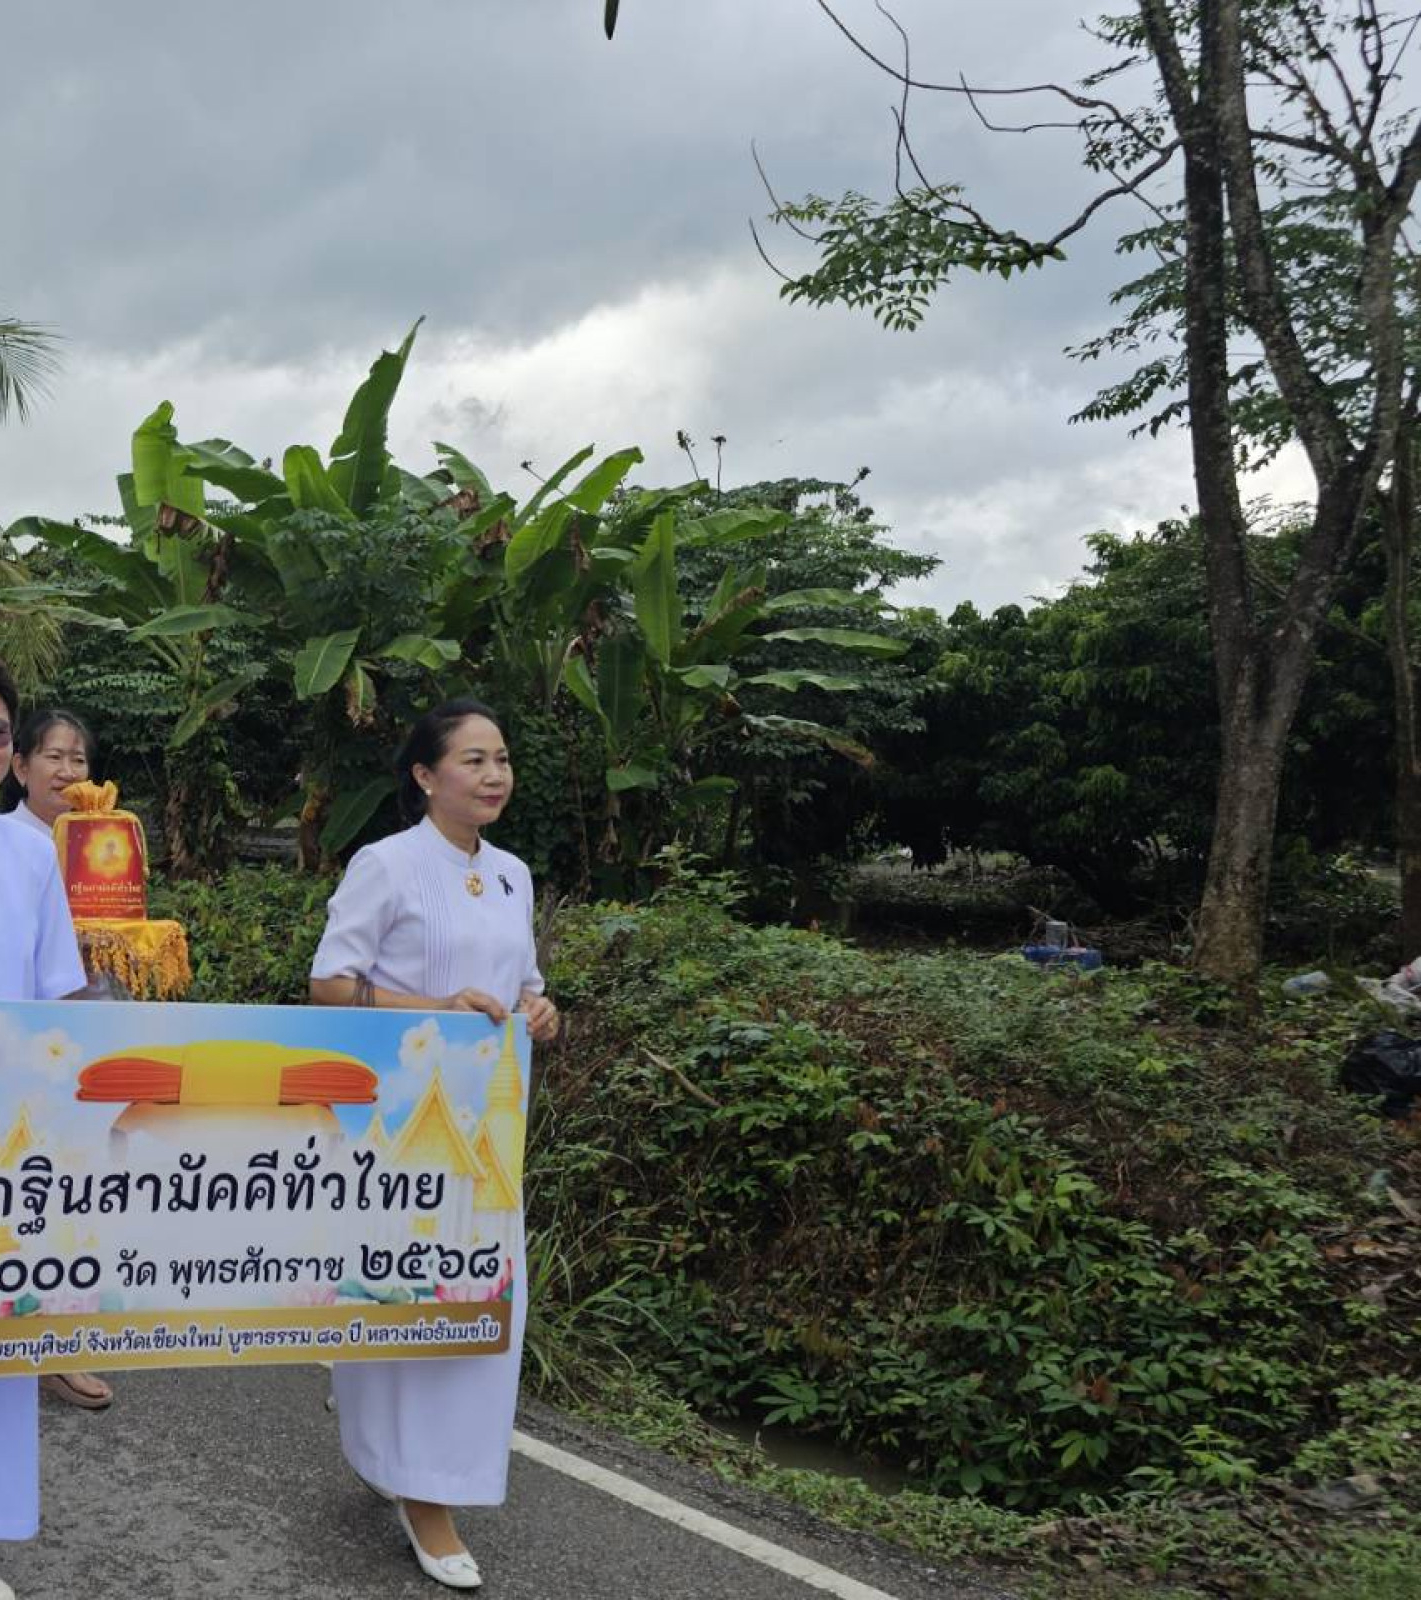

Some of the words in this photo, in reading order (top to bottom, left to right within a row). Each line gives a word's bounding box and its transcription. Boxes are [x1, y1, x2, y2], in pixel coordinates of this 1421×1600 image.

[117, 1248, 157, 1287] วัด
[169, 1246, 345, 1299] พุทธศักราช
[361, 1241, 501, 1281] ๒๕๖๘
[87, 1325, 222, 1351] จังหวัดเชียงใหม่
[228, 1328, 312, 1353] บูชาธรรม
[350, 1320, 362, 1343] ปี
[367, 1319, 499, 1343] หลวงพ่อธัมมชโย
